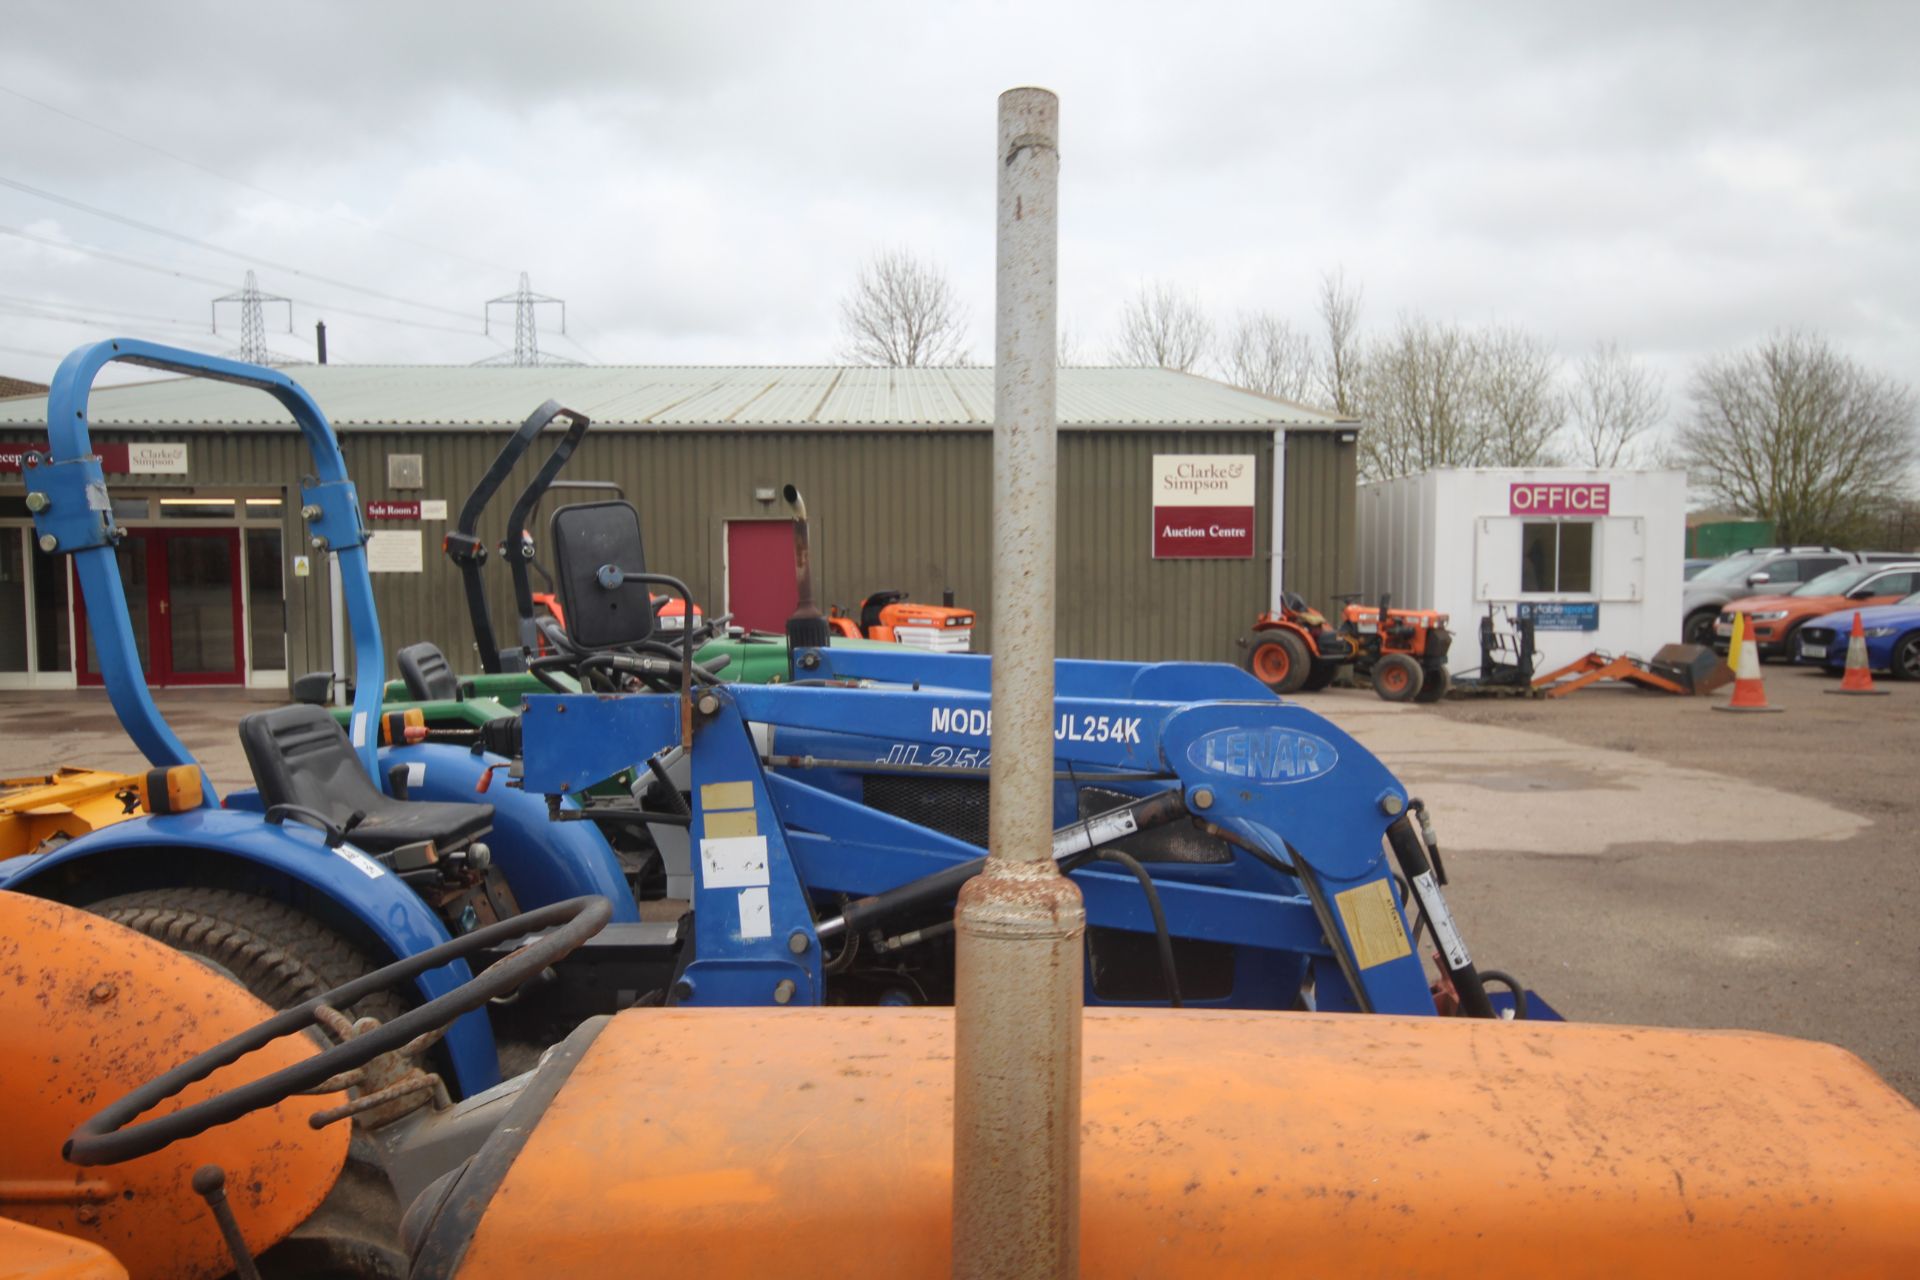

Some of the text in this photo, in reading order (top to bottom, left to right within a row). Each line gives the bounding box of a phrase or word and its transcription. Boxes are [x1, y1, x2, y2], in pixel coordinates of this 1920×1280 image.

[132, 456, 174, 468] Simpson
[1163, 475, 1228, 494] Simpson
[1513, 487, 1606, 509] OFFICE
[369, 505, 386, 515] Sale
[387, 505, 411, 515] Room
[413, 505, 418, 515] 2
[1162, 525, 1246, 538] Auction Centre
[1055, 714, 1141, 744] JL254K
[1206, 731, 1320, 778] LENAR
